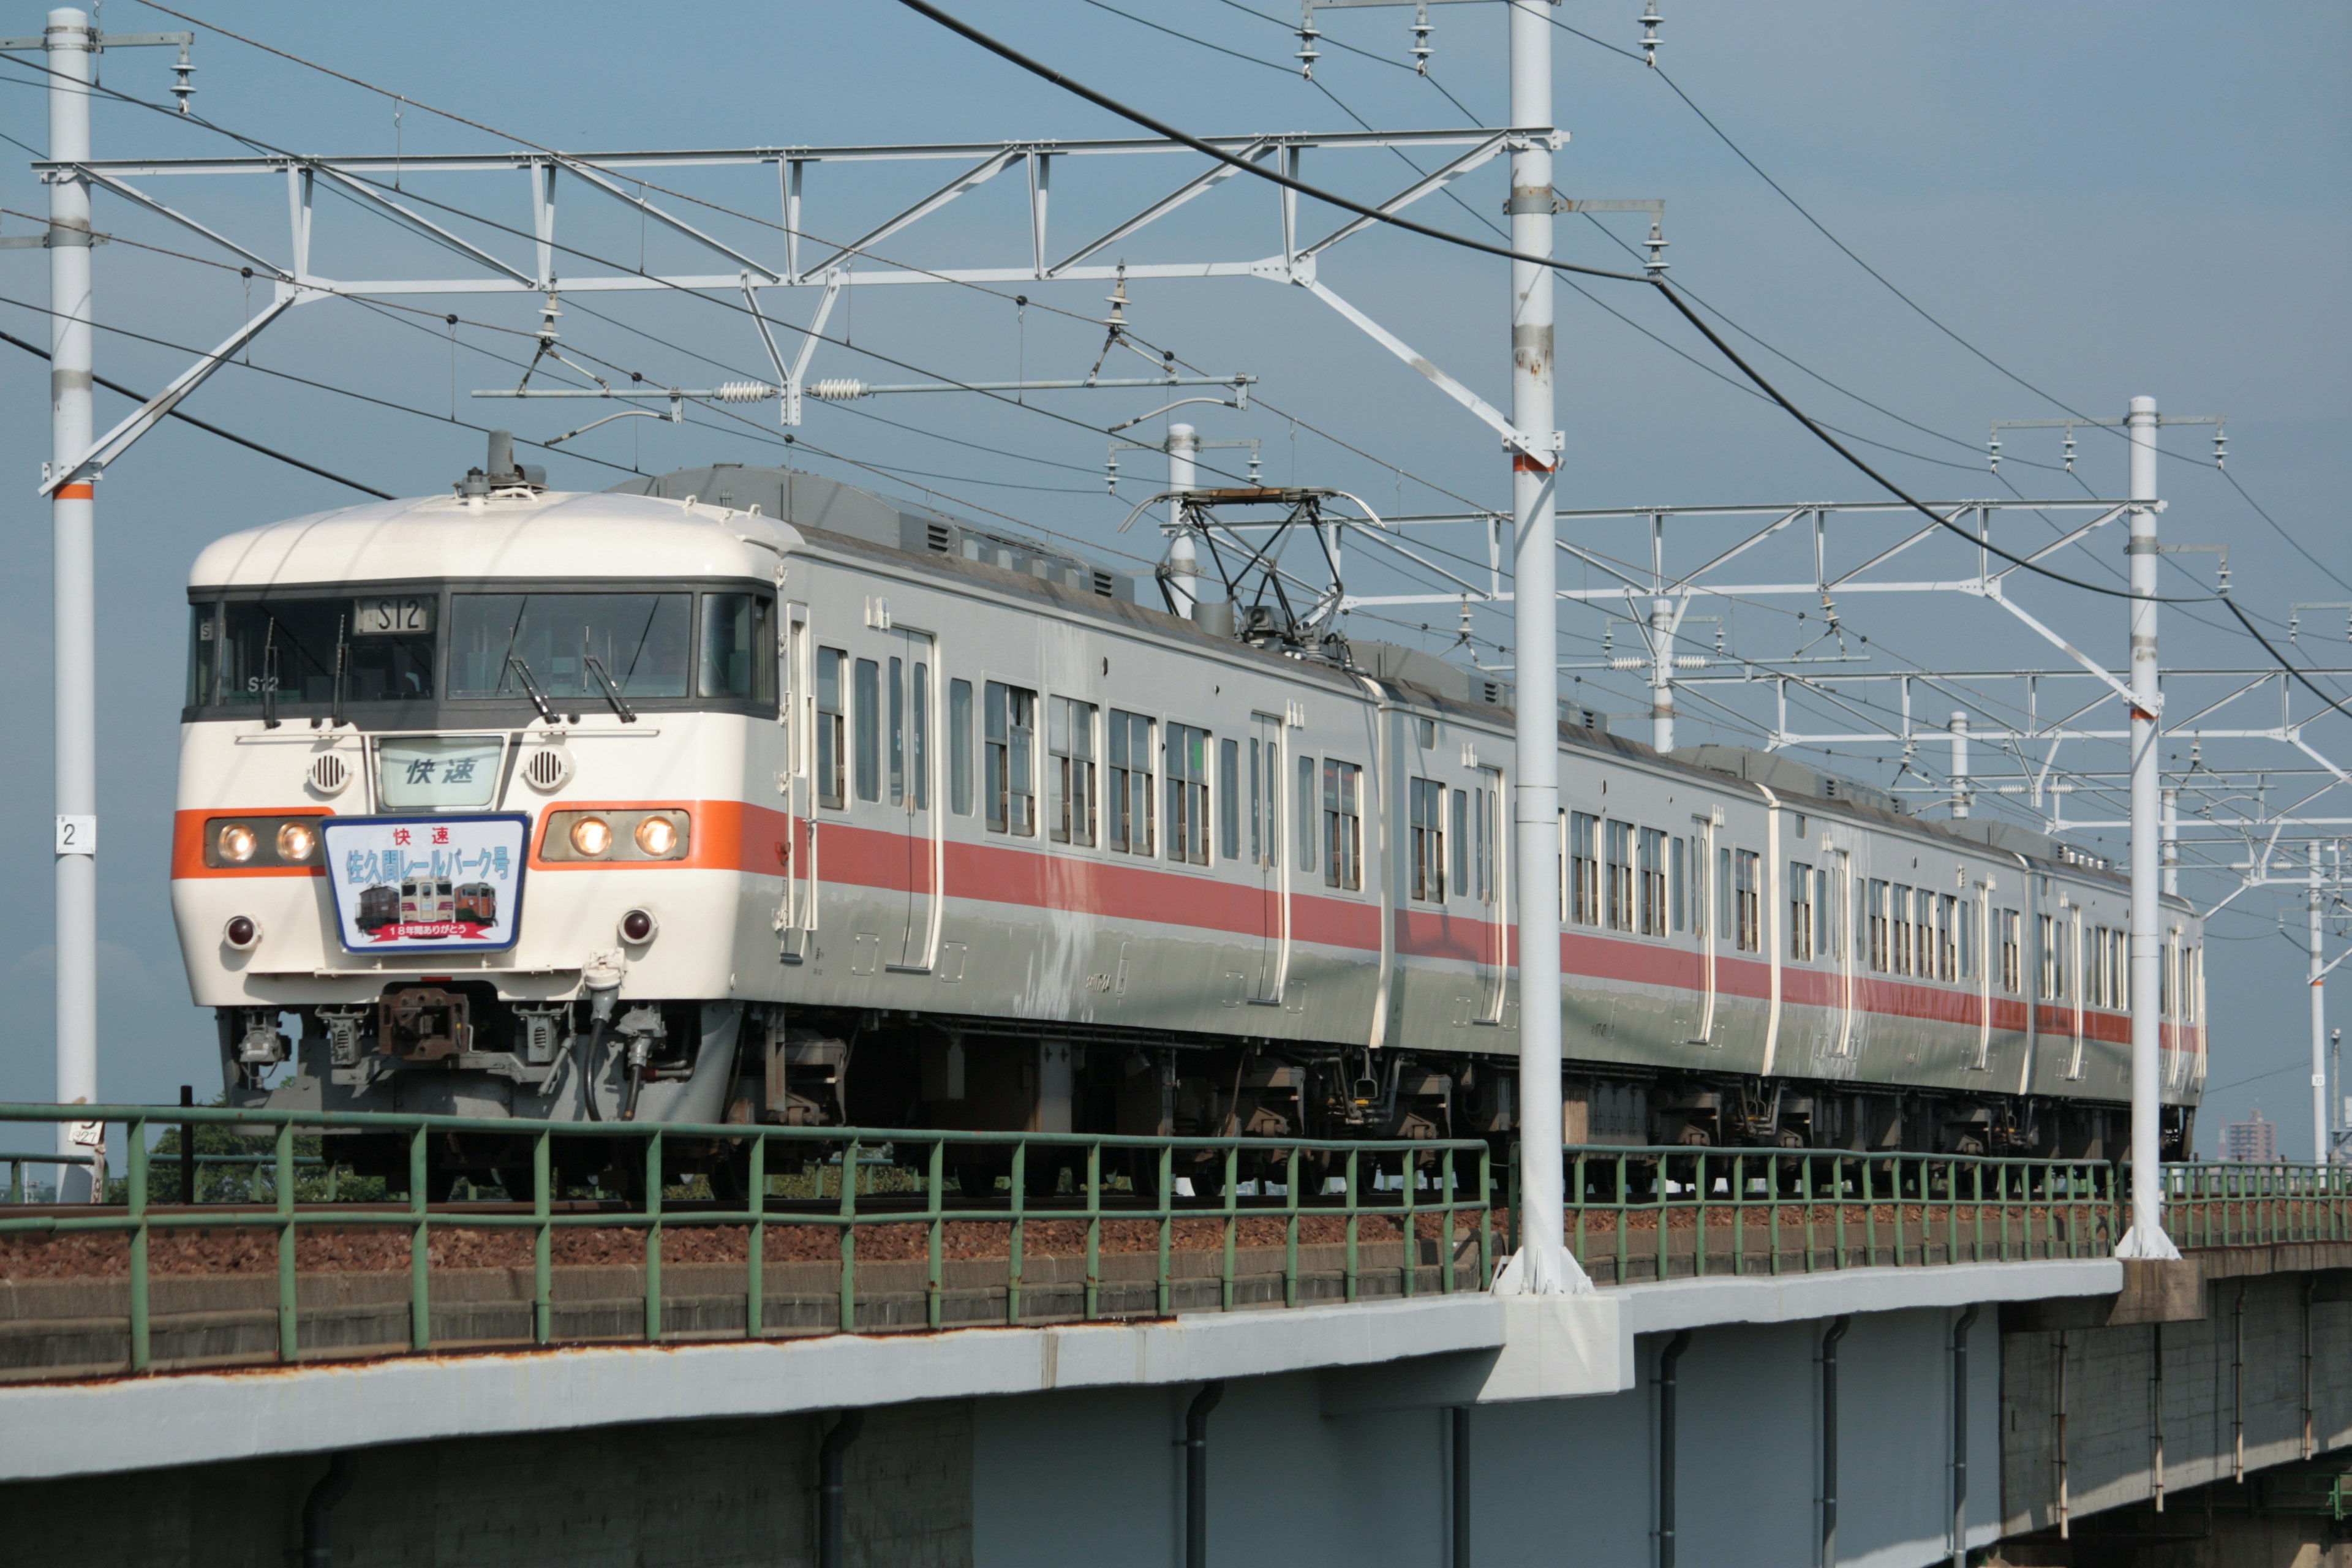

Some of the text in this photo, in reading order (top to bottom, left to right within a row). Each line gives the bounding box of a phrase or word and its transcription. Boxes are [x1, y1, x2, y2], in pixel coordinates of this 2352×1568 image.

[379, 600, 419, 630] S12
[202, 625, 209, 637] S
[247, 676, 279, 692] S12
[406, 758, 479, 784] 快速
[393, 827, 449, 846] 快速
[346, 846, 510, 884] 佐久間レールパーク号
[390, 924, 467, 935] 18年間ありがとう
